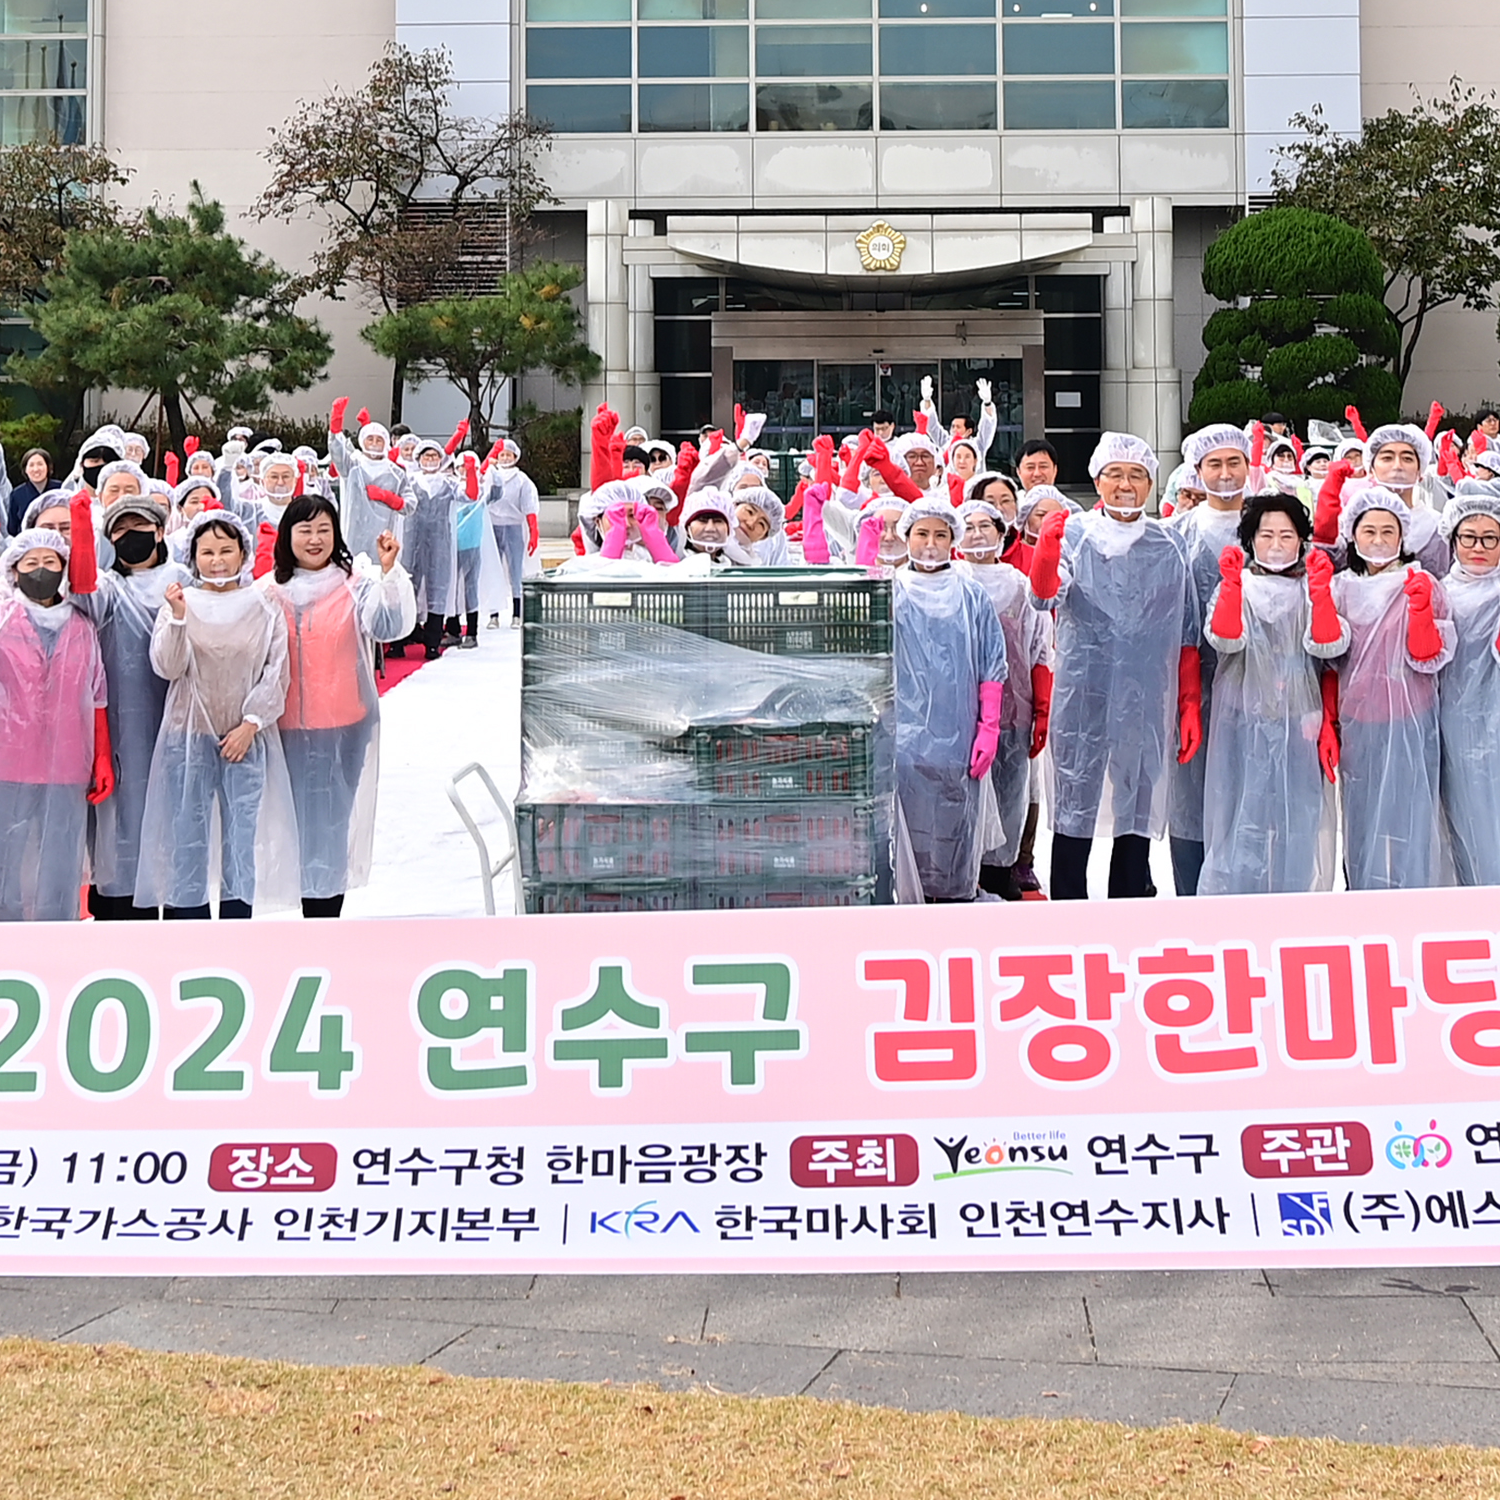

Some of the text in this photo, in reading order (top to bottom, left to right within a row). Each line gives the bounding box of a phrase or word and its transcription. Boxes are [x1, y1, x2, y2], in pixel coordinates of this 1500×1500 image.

[417, 961, 801, 1092] 연수구
[62, 1151, 188, 1185] 11:00
[227, 1146, 316, 1189] 장소
[352, 1145, 525, 1187] 연수구청
[546, 1142, 768, 1185] 한마음광장
[808, 1137, 896, 1184] 주최
[932, 1135, 1069, 1174] Yeonsu
[1087, 1133, 1220, 1176] 연수구
[1260, 1125, 1352, 1174] 주관
[1012, 1130, 1067, 1141] Better life
[273, 1206, 541, 1243] 인천기지본부
[589, 1204, 702, 1237] KRA
[714, 1202, 937, 1241] 한국마사회
[959, 1196, 1231, 1239] 인천연수지사
